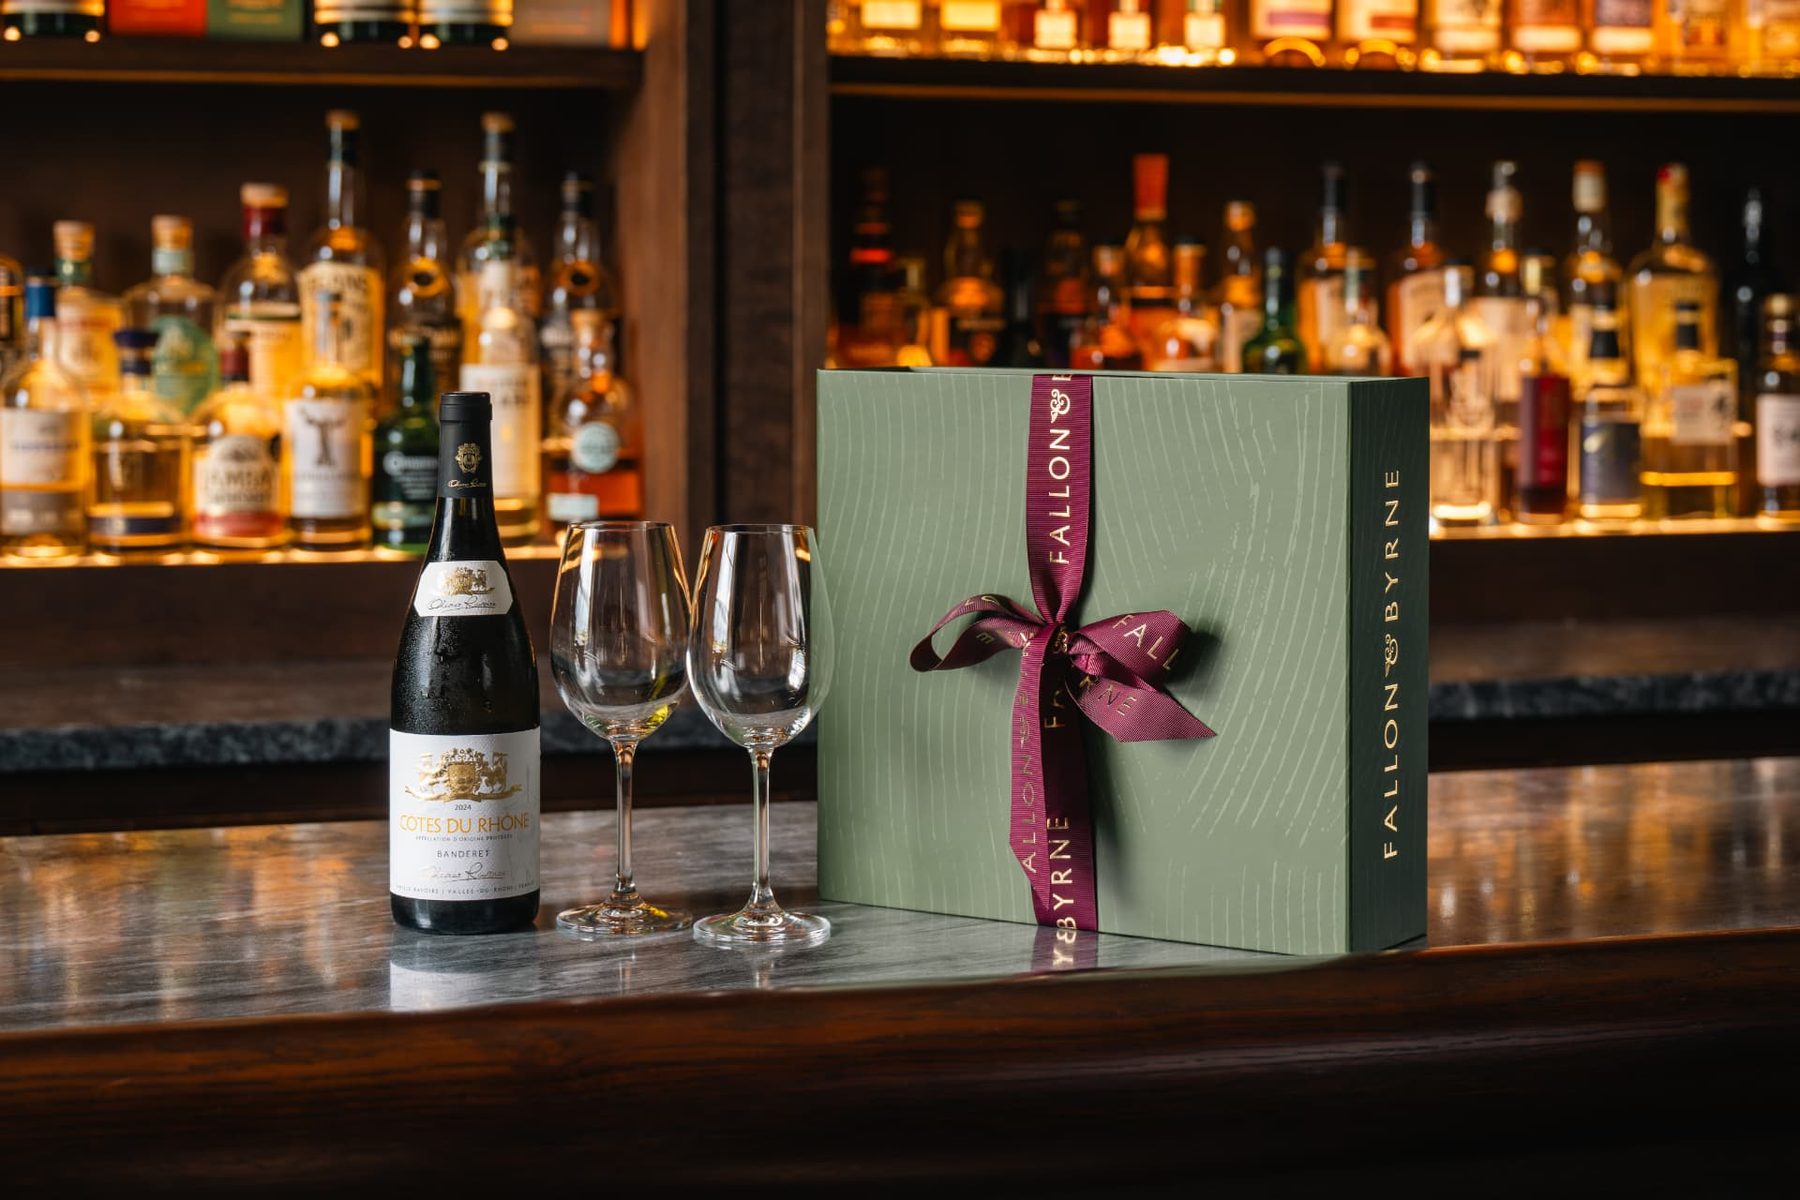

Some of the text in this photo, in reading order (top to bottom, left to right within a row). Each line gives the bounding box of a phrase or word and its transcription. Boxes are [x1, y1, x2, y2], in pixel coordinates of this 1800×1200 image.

[1049, 428, 1071, 565] FALLON
[1384, 470, 1400, 623] BYRNE
[447, 818, 471, 834] DU
[1384, 683, 1399, 860] FALLON
[437, 850, 489, 858] BANDERET
